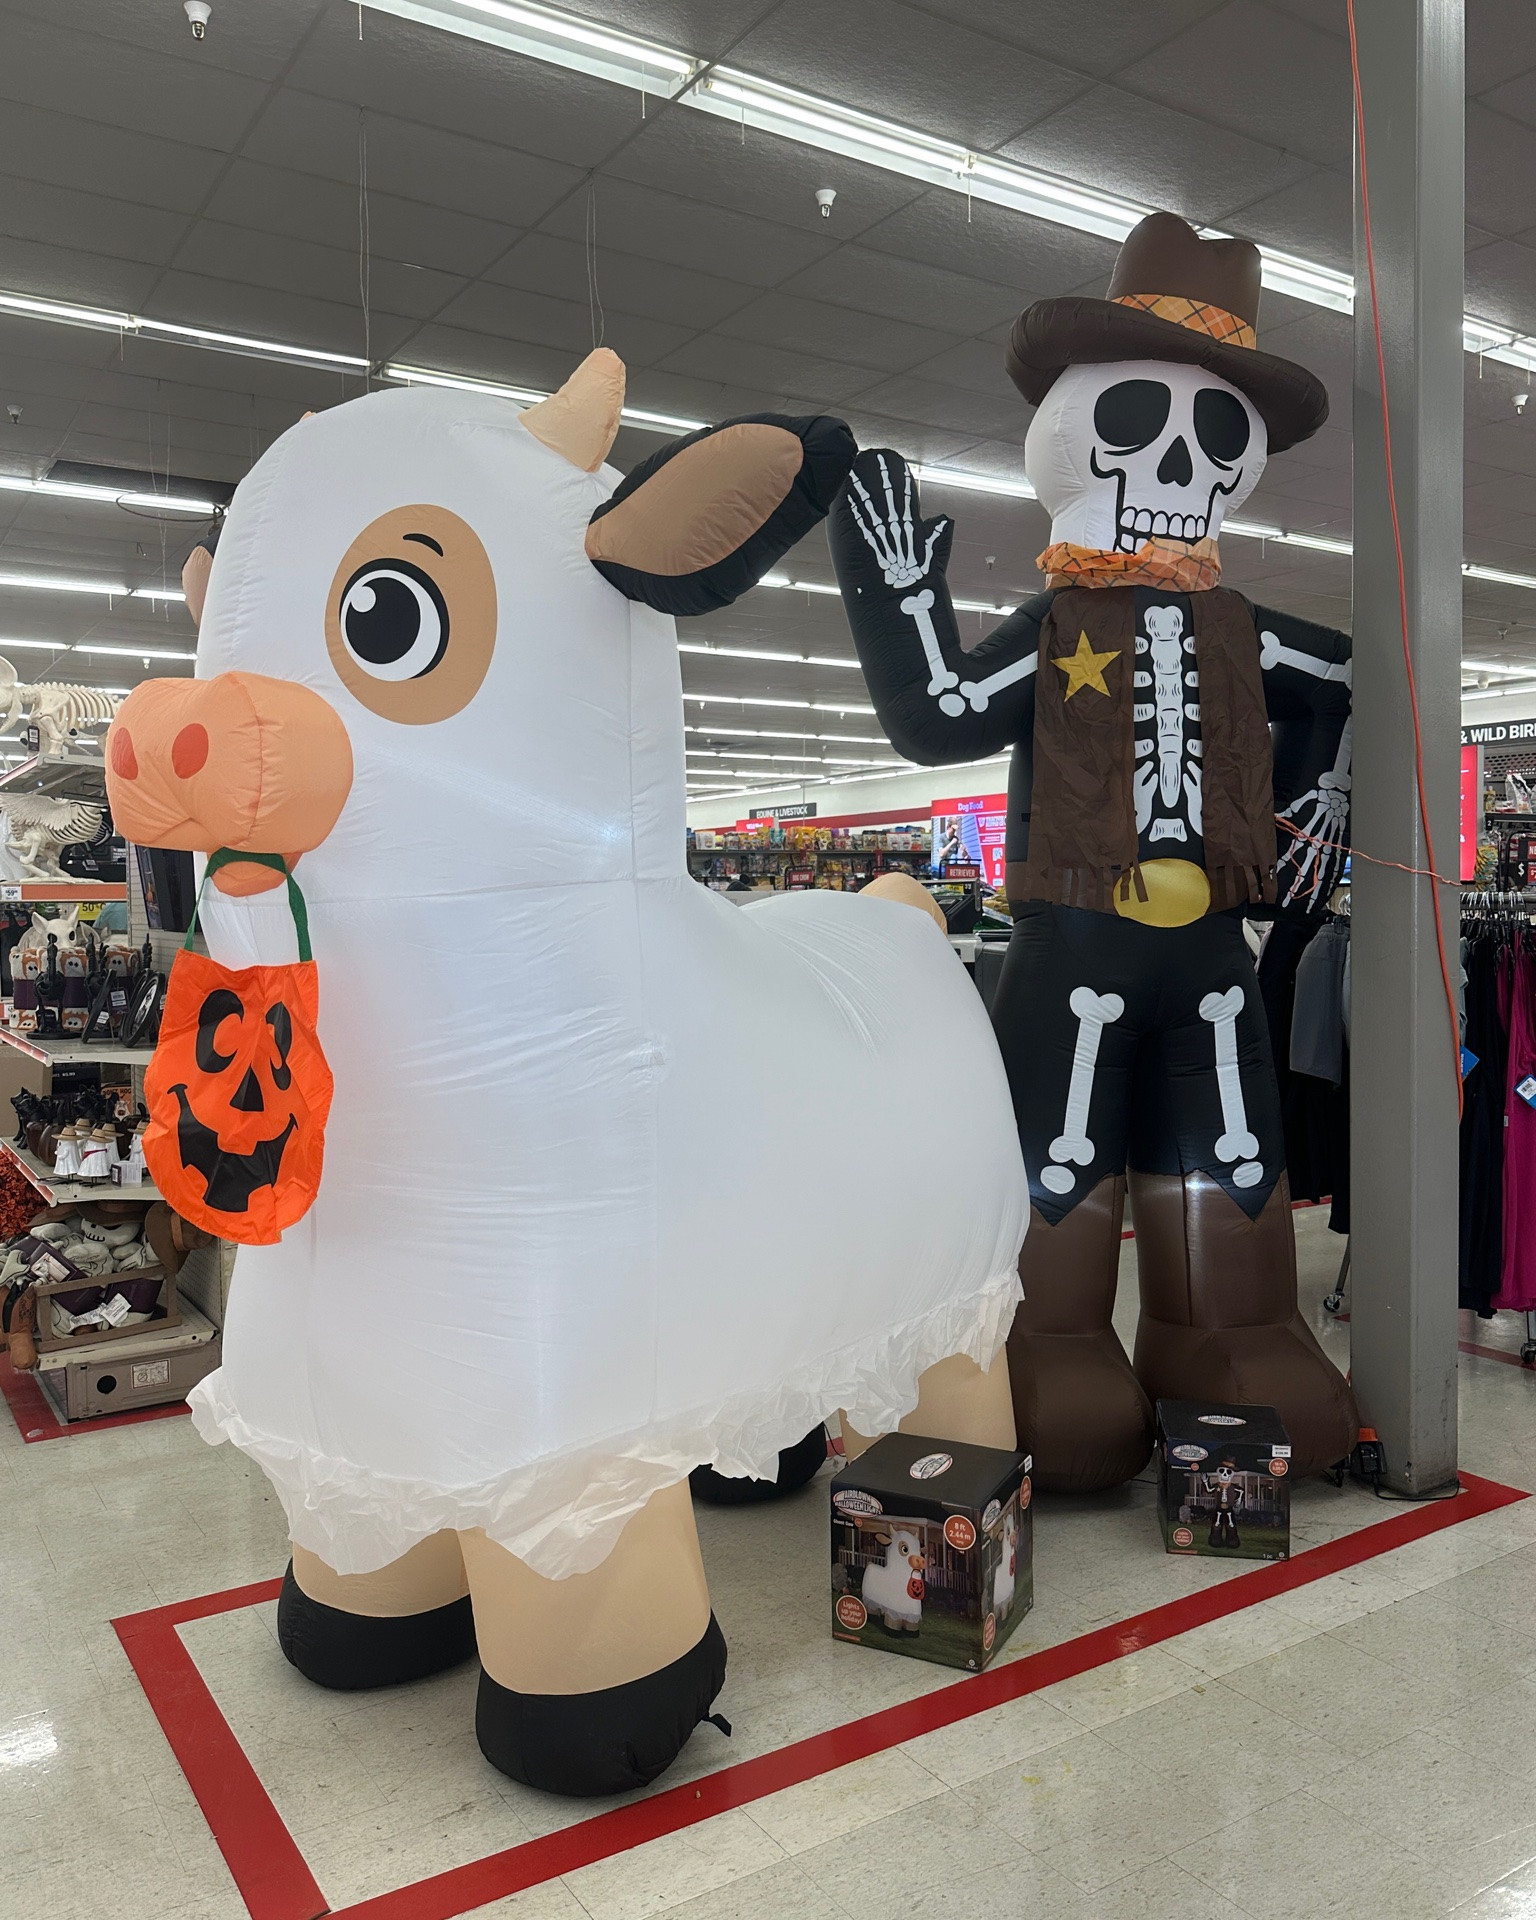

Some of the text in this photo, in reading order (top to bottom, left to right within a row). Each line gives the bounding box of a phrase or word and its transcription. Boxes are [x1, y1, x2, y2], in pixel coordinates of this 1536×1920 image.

[1461, 731, 1468, 744] &
[1470, 726, 1507, 743] WILD
[780, 805, 808, 817] LIVESTOCK
[957, 801, 983, 812] Dog Food
[949, 868, 976, 877] RETRIEVER
[1518, 862, 1525, 877] $
[954, 1522, 965, 1531] 8 ft
[949, 1530, 963, 1538] 2.44
[843, 1601, 860, 1610] Lights
